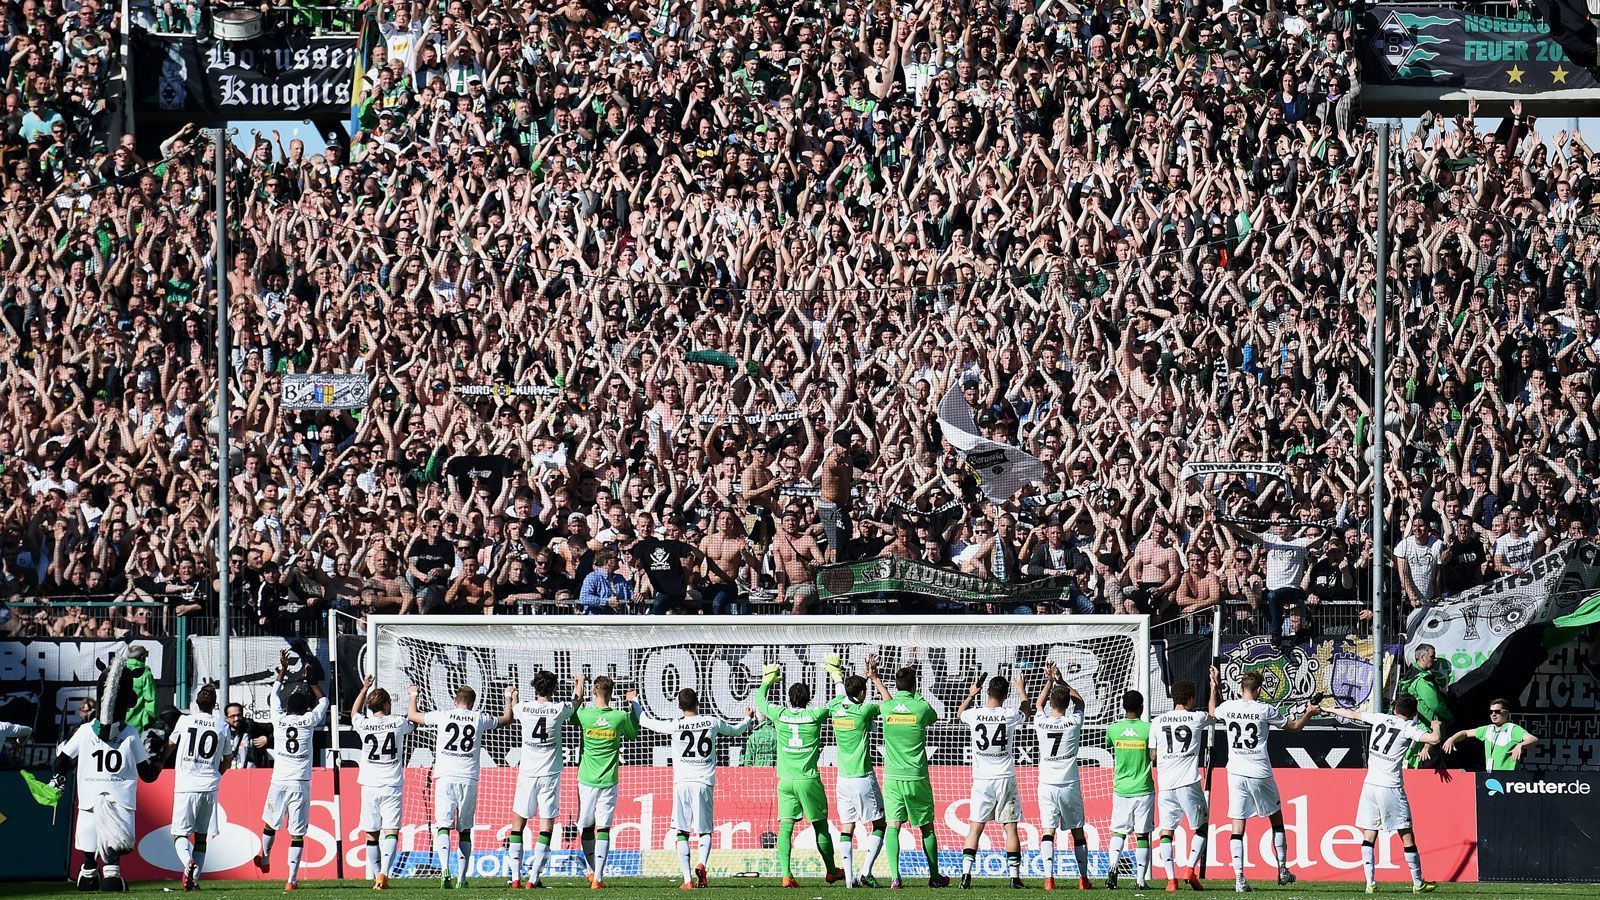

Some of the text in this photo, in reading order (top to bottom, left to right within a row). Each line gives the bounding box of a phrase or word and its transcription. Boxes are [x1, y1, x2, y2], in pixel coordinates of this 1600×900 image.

[1464, 40, 1571, 62] FEUER 20
[219, 74, 351, 111] Knights
[461, 385, 550, 395] NORD KURVE
[194, 718, 216, 728] KRUSE
[363, 722, 398, 731] JANTSCHKE
[449, 713, 474, 723] HAHN
[678, 721, 712, 731] HAZARD
[975, 714, 1007, 722] XHAKA
[1038, 721, 1074, 730] HERRMANN
[1159, 714, 1194, 724] JOHNSON
[1226, 712, 1260, 721] KRAMER
[285, 726, 300, 754] 8
[443, 722, 476, 753] 28
[531, 716, 549, 744] 4
[787, 722, 803, 747] 1
[975, 723, 1009, 751] 34
[1161, 724, 1194, 754] 19
[1228, 721, 1260, 750] 23
[1370, 723, 1402, 755] 27
[187, 727, 218, 760] 10
[363, 731, 398, 760] 24
[679, 729, 713, 758] 26
[1046, 732, 1064, 757] 7
[91, 749, 122, 773] 10
[1505, 779, 1591, 796] reuter.de
